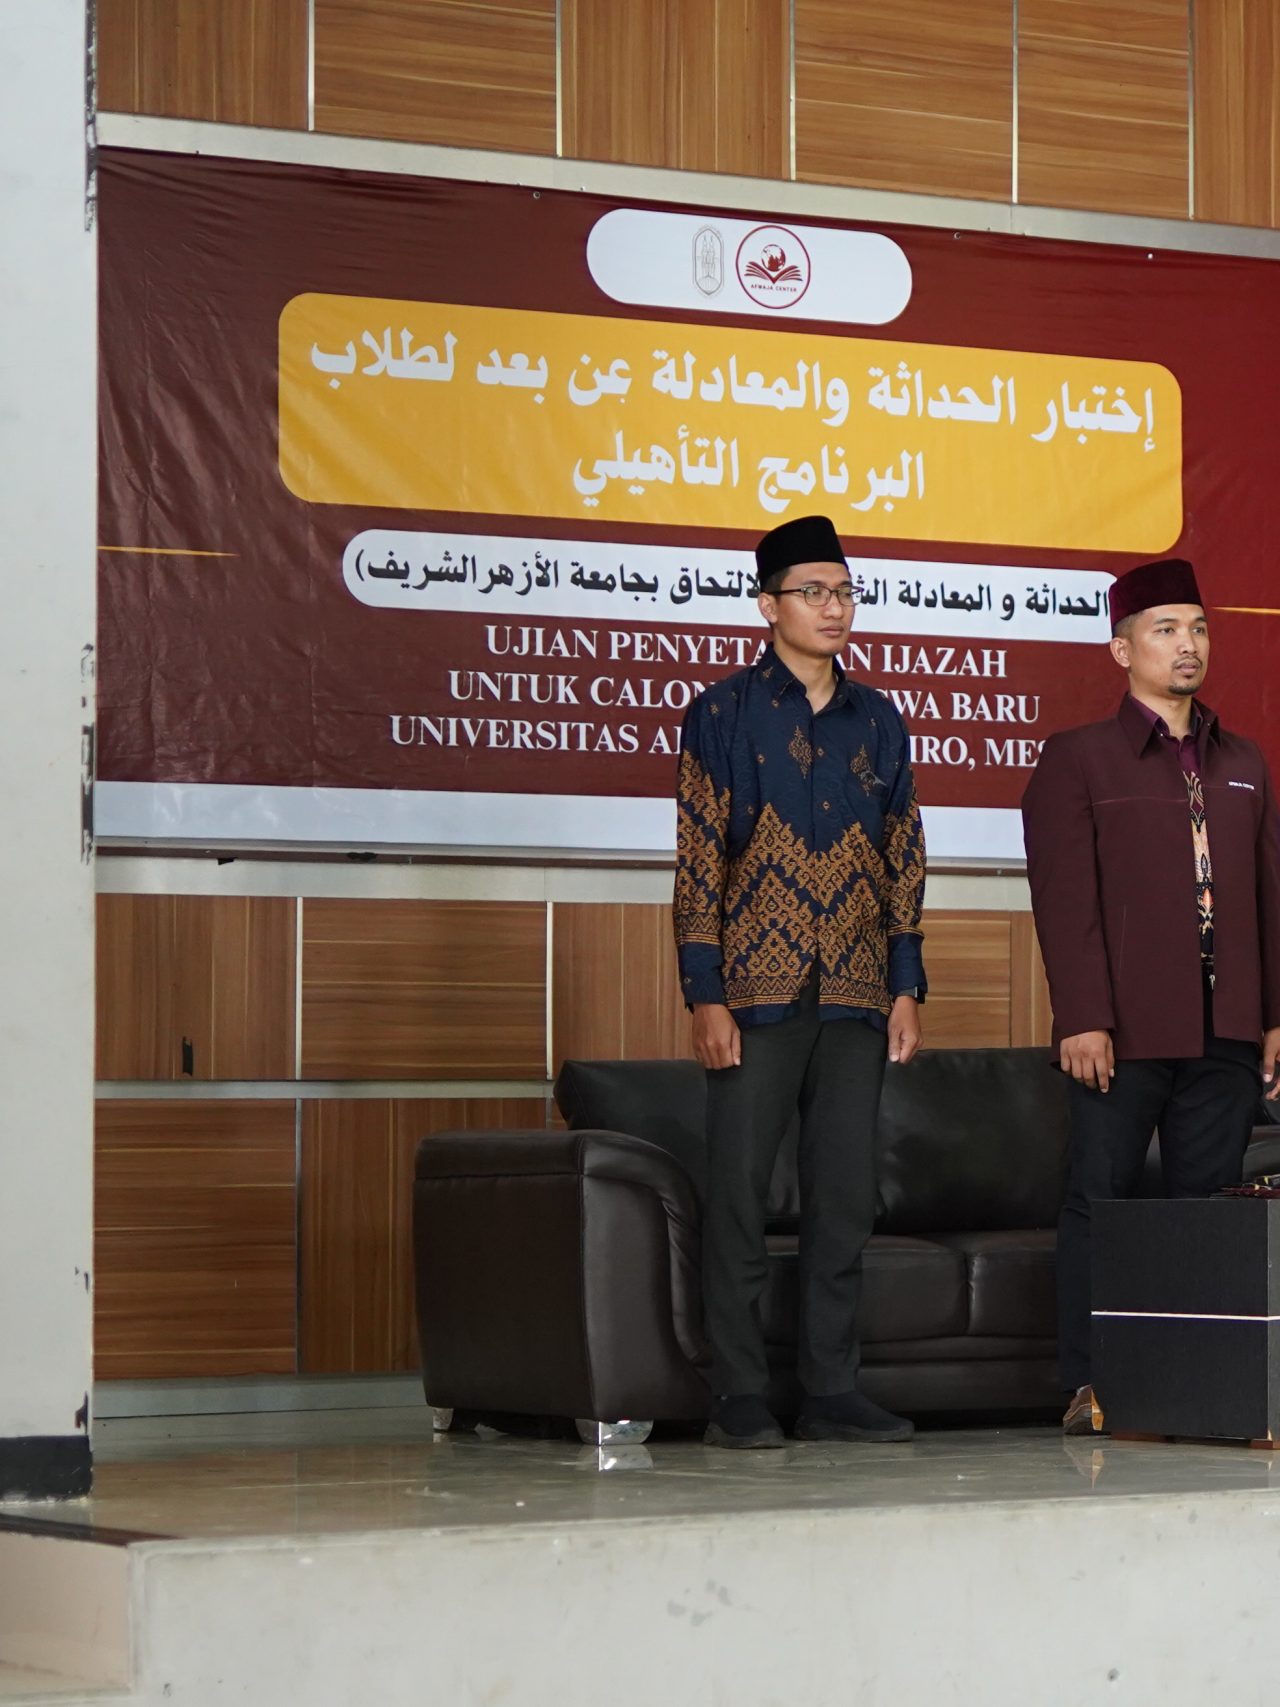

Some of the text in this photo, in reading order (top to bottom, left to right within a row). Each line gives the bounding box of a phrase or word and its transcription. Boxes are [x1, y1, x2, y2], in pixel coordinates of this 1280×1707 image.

[310, 325, 1156, 453] إختبار الحداثة والمعادلة عن بعد لطلاب
[571, 423, 926, 515] البرنامج التأهيلي
[569, 560, 659, 603] بجامعة
[897, 579, 993, 613] المعادلة
[1025, 583, 1110, 618] الحداثة
[485, 625, 599, 659] UJIAN
[881, 643, 1007, 679] IJAZAH
[448, 670, 580, 705] UNTUK
[951, 691, 1041, 724] BARU
[389, 715, 640, 754] UNIVERSITAS
